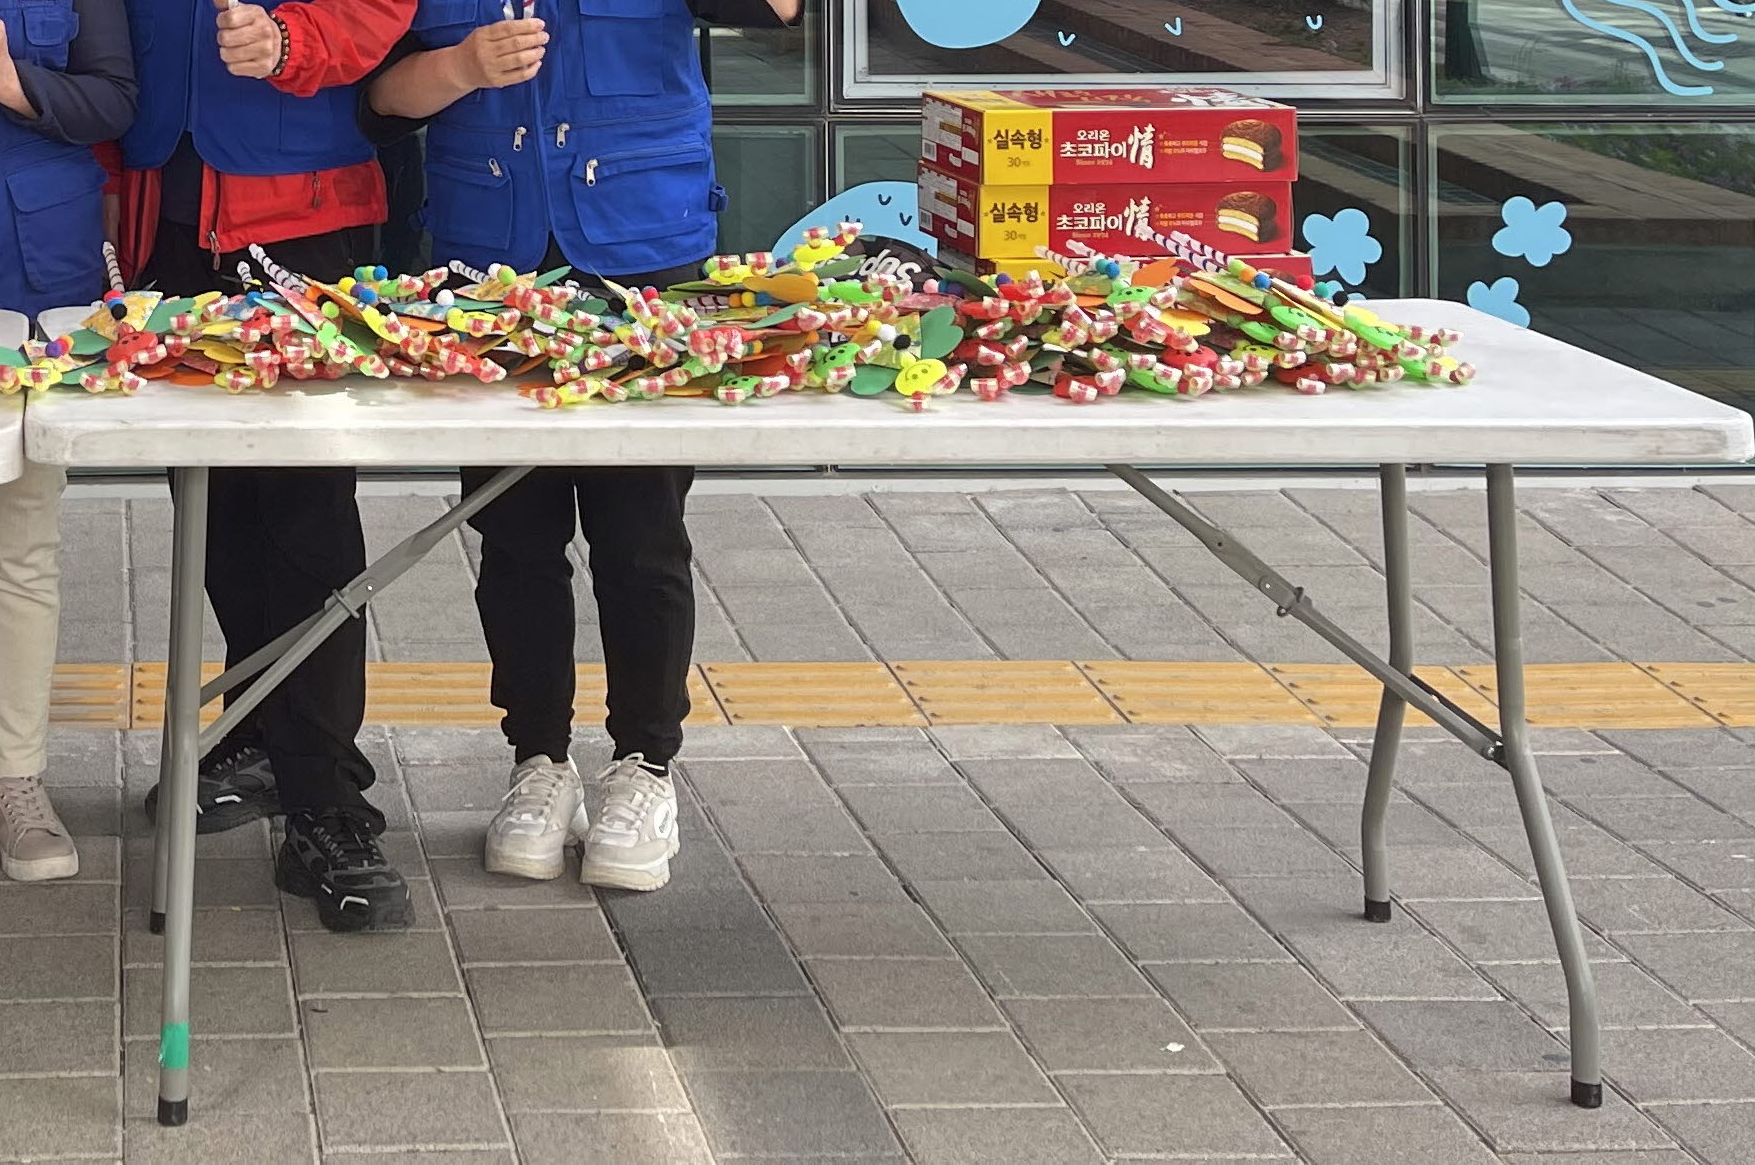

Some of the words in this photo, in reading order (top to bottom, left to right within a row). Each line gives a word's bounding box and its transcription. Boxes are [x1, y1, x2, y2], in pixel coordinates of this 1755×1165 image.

[992, 128, 1043, 151] 실속형
[1076, 129, 1111, 142] 오리온
[1059, 140, 1127, 159] 초코파이
[1127, 123, 1156, 170] 情
[988, 201, 1040, 224] 실속형
[1072, 202, 1107, 214] 오리온
[1055, 213, 1124, 233] 초코파이
